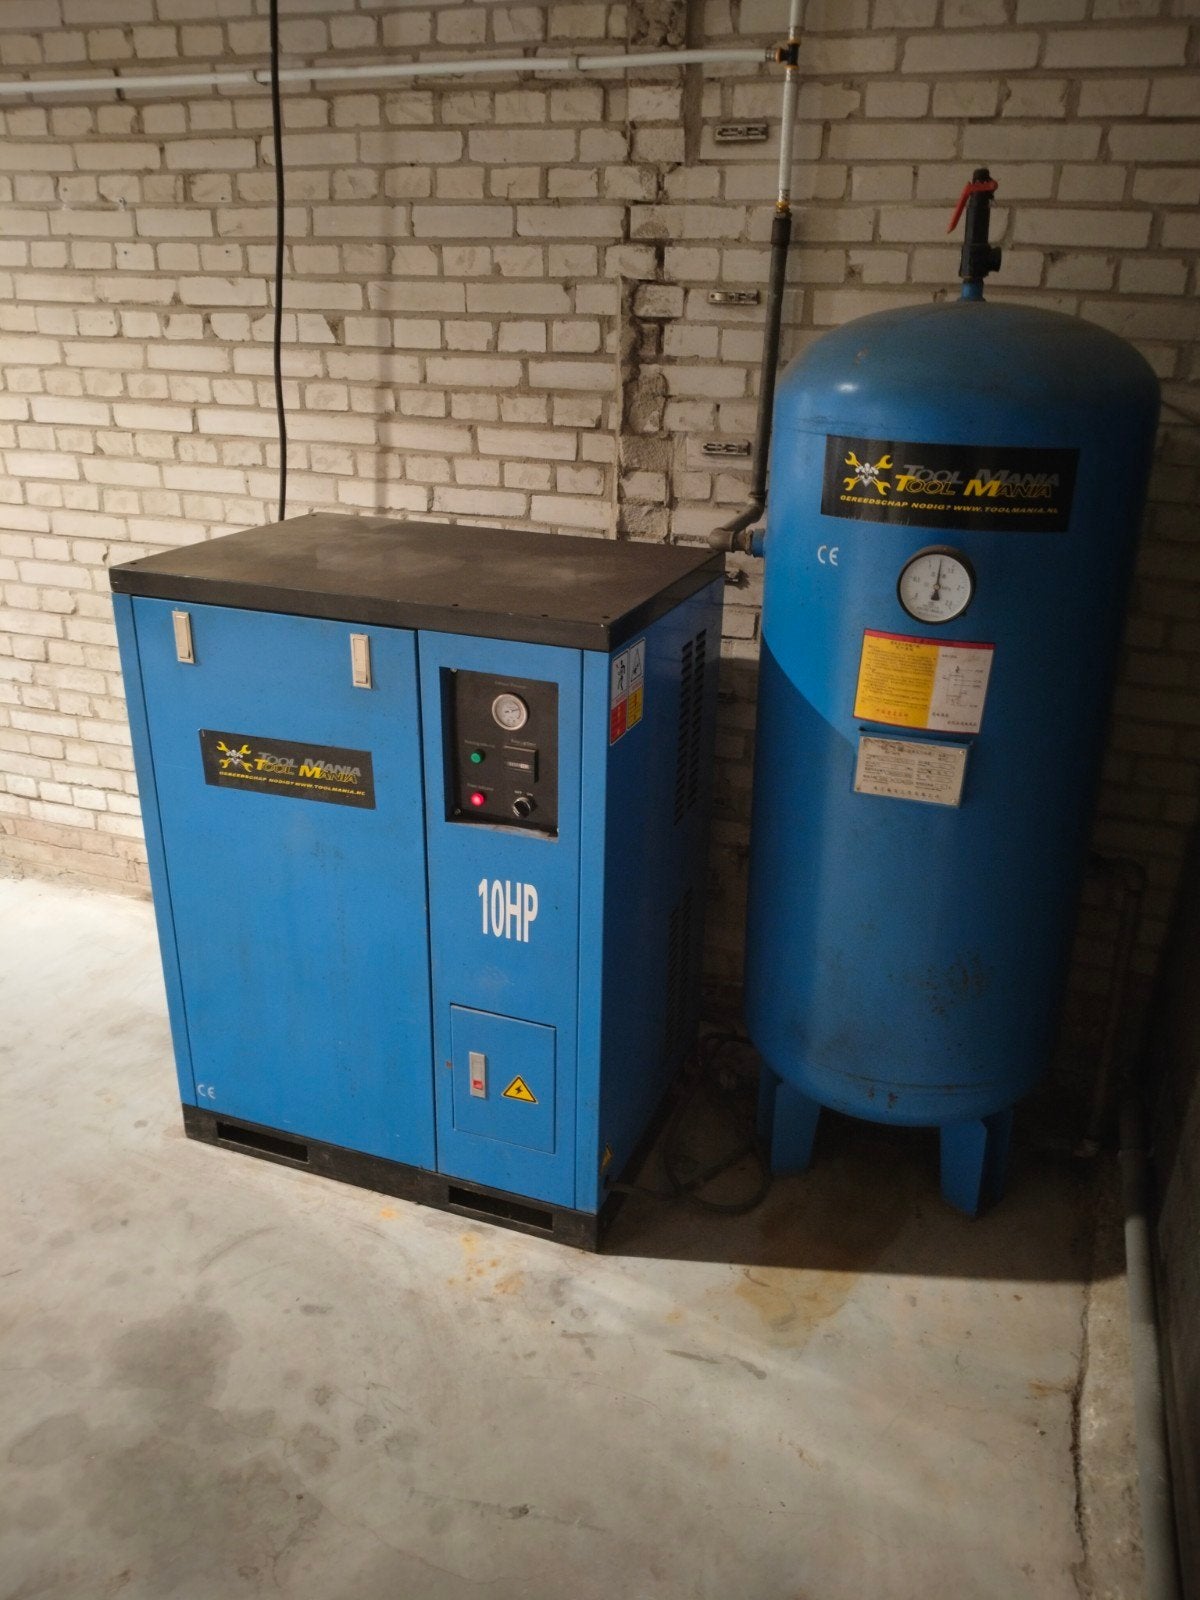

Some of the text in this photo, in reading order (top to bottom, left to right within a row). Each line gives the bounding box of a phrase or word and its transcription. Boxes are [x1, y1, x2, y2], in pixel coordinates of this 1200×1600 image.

[840, 495, 908, 507] GEREEDSCHAP
[817, 545, 839, 567] CE
[478, 878, 538, 943] 10HP
